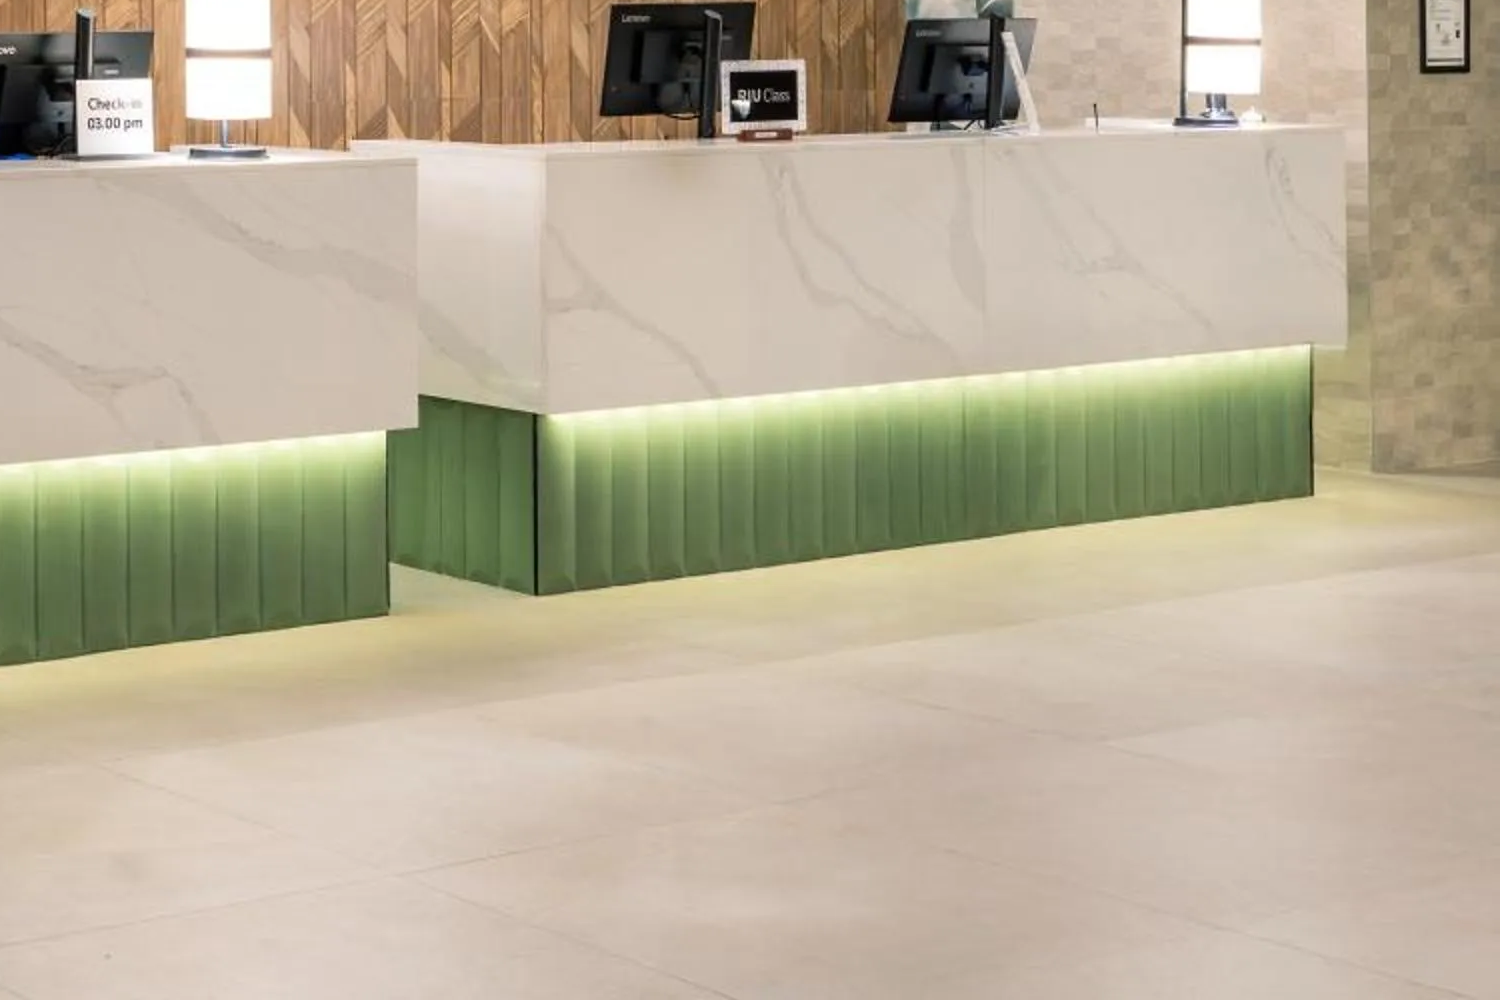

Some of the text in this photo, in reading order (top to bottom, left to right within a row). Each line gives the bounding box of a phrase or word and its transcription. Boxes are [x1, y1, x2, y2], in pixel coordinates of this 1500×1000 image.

[737, 88, 791, 103] RIU Class
[87, 97, 143, 110] Check-
[123, 119, 143, 132] pm
